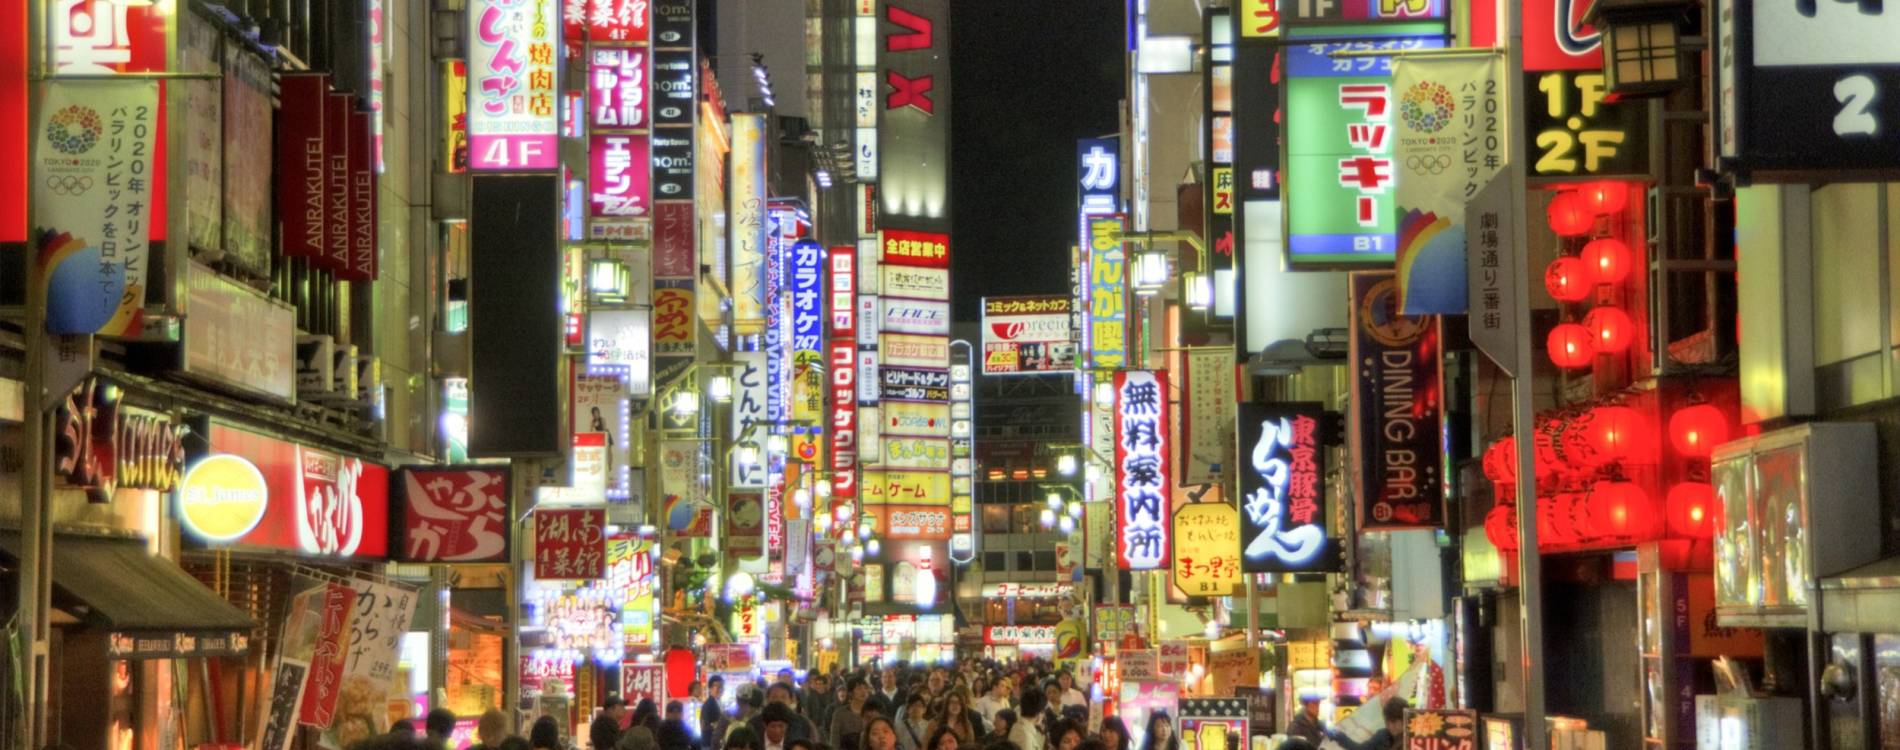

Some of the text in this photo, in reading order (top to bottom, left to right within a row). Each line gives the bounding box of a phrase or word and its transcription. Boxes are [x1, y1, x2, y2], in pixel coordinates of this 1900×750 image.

[596, 69, 618, 125] ルーム
[621, 50, 643, 126] レンタル
[1833, 75, 1877, 136] 2
[483, 138, 544, 166] 4F
[605, 138, 631, 194] エデン
[1340, 84, 1390, 224] ラッキー
[1535, 131, 1625, 172] 2F
[306, 137, 323, 250] ANRAKUTEI
[332, 154, 348, 263] ANRAKUTEI
[356, 170, 372, 275] ANRAKUTEI
[886, 238, 946, 258] 全店営業中
[1354, 237, 1384, 250] B1
[1481, 211, 1500, 330] 劇場通り一番街
[796, 245, 818, 334] カラオケ
[795, 335, 818, 349] 747
[1382, 351, 1415, 443] DINING
[1124, 380, 1162, 559] 無料案内所
[1289, 413, 1318, 524] 東京豚骨
[1386, 449, 1418, 500] BAR
[1199, 581, 1219, 592] B1
